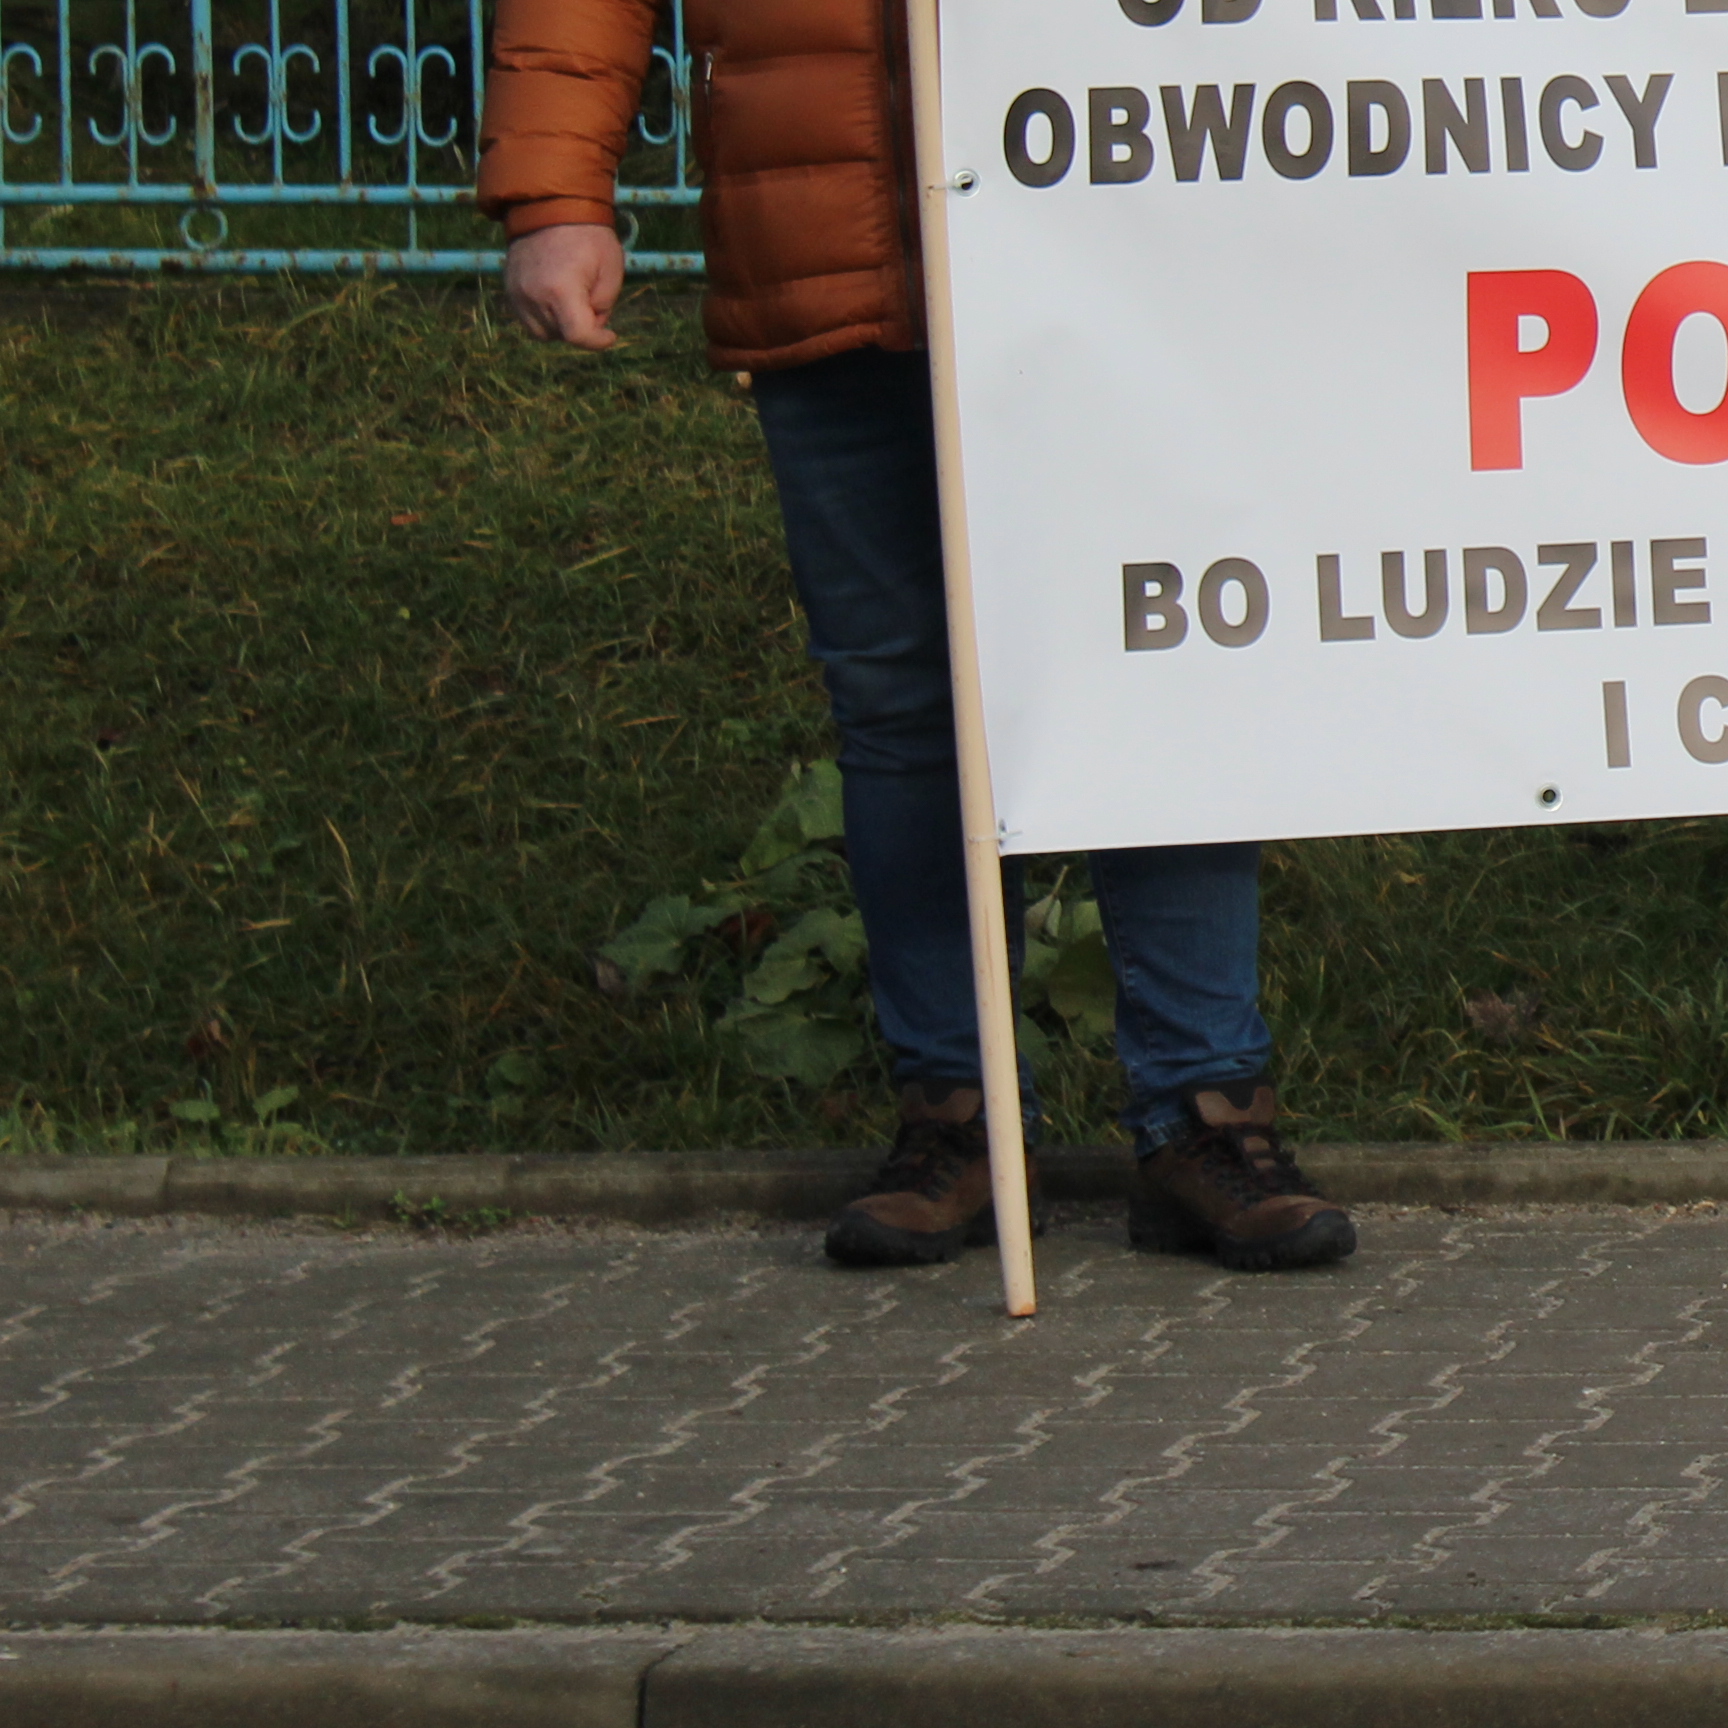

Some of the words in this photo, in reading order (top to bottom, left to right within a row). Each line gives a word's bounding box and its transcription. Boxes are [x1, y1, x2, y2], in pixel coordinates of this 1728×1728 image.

[1003, 74, 1673, 188] OBWODNICY
[1122, 557, 1269, 652] BO
[1317, 537, 1710, 642] LUDZIE
[1603, 681, 1630, 767] I
